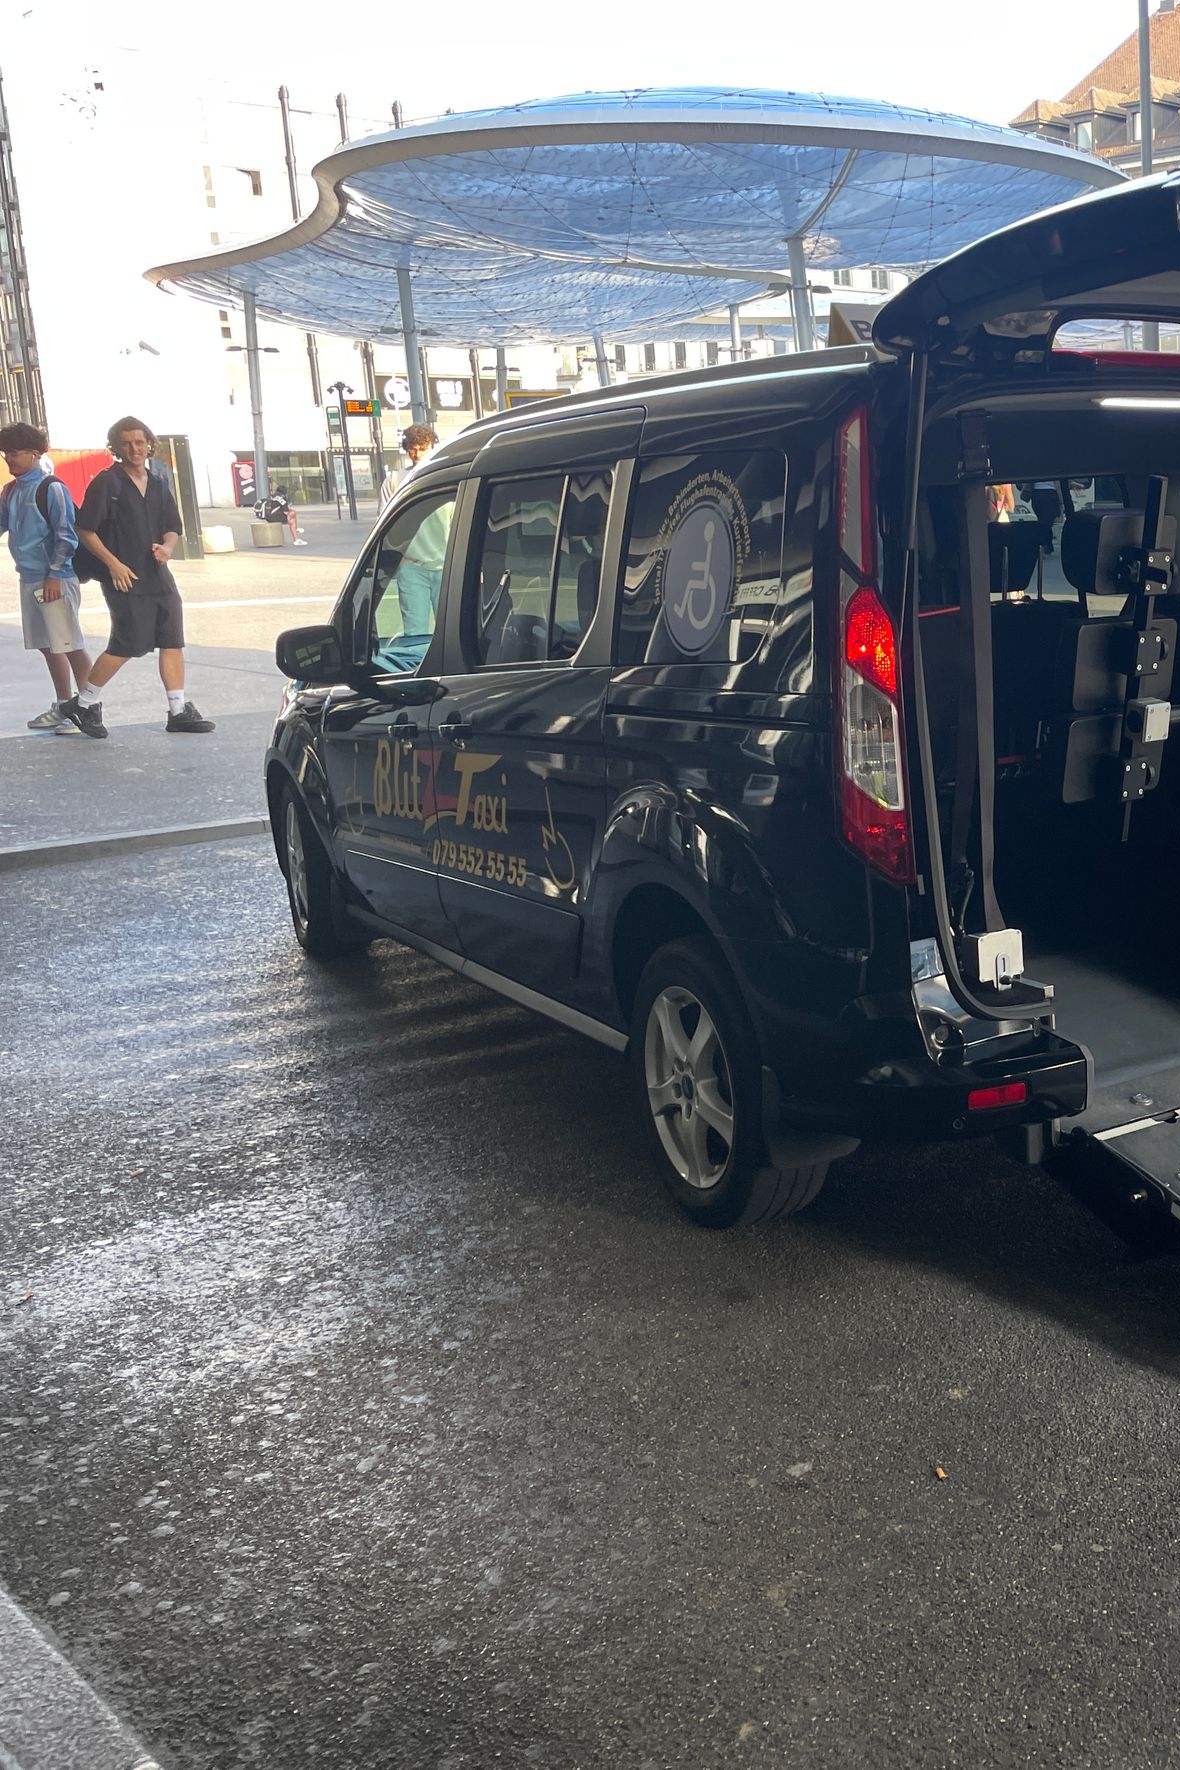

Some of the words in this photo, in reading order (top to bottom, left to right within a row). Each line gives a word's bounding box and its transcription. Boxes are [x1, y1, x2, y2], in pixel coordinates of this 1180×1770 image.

[454, 752, 509, 834] Taxi
[432, 839, 456, 868] 079
[457, 844, 483, 876] 552
[486, 852, 505, 882] 55
[507, 856, 527, 887] 55
